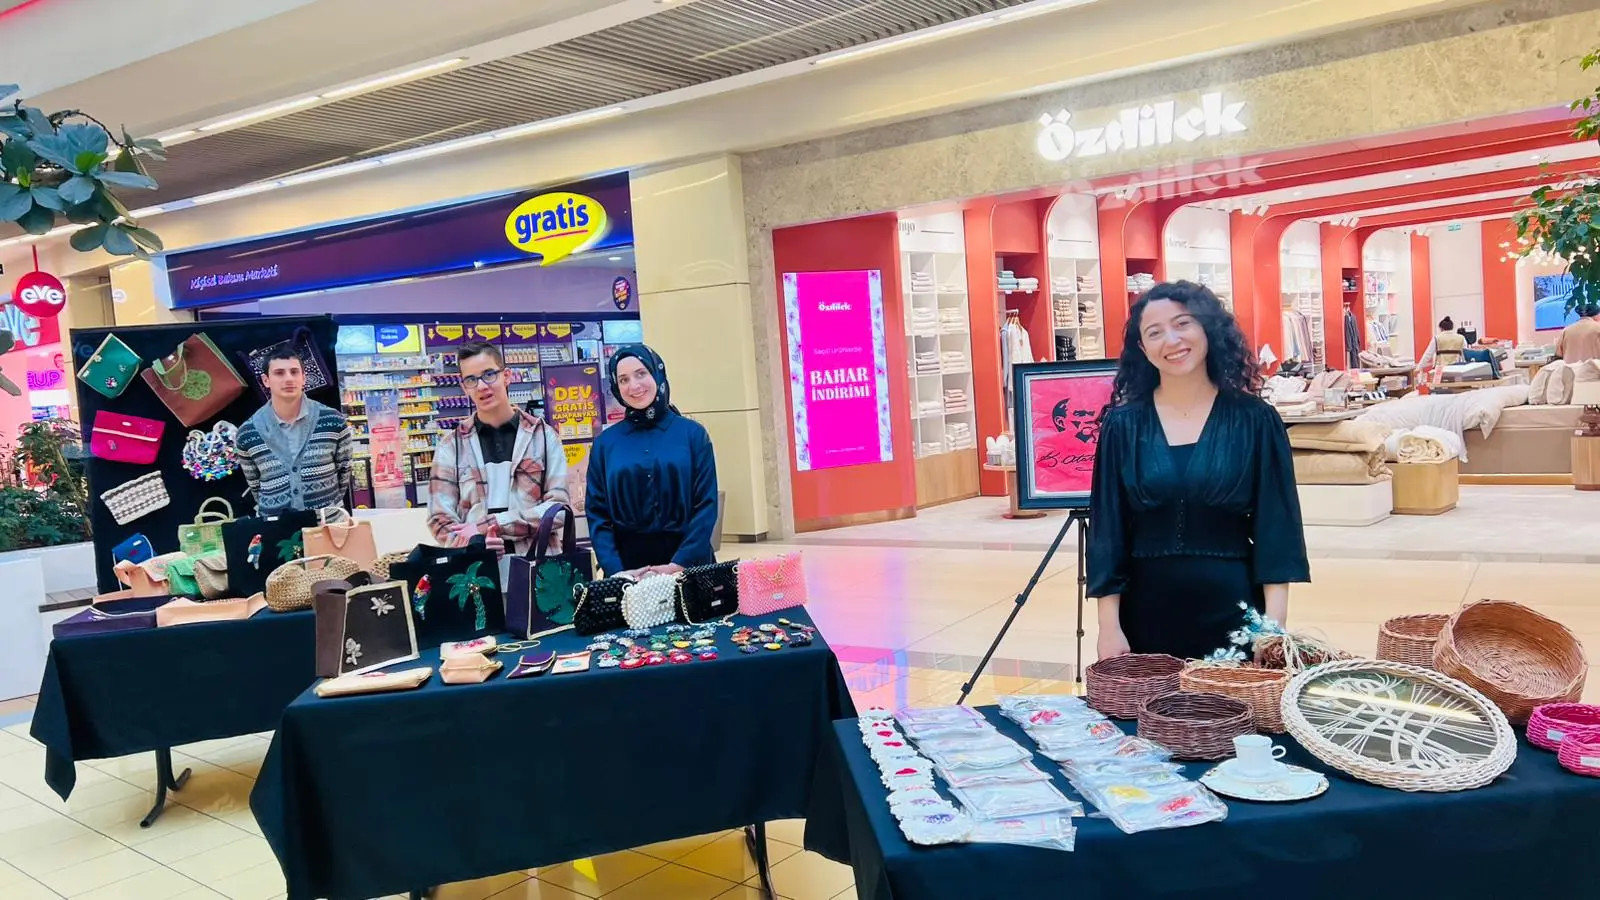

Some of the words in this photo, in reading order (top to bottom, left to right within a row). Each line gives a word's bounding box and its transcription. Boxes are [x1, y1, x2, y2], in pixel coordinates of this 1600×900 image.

[1037, 92, 1248, 161] Özdilek
[515, 198, 589, 243] gratis
[20, 285, 65, 305] eve
[818, 300, 852, 311] Özdilek
[810, 367, 869, 386] BAHAR
[554, 385, 593, 402] DEV
[812, 384, 870, 402] İNDİRİMİ
